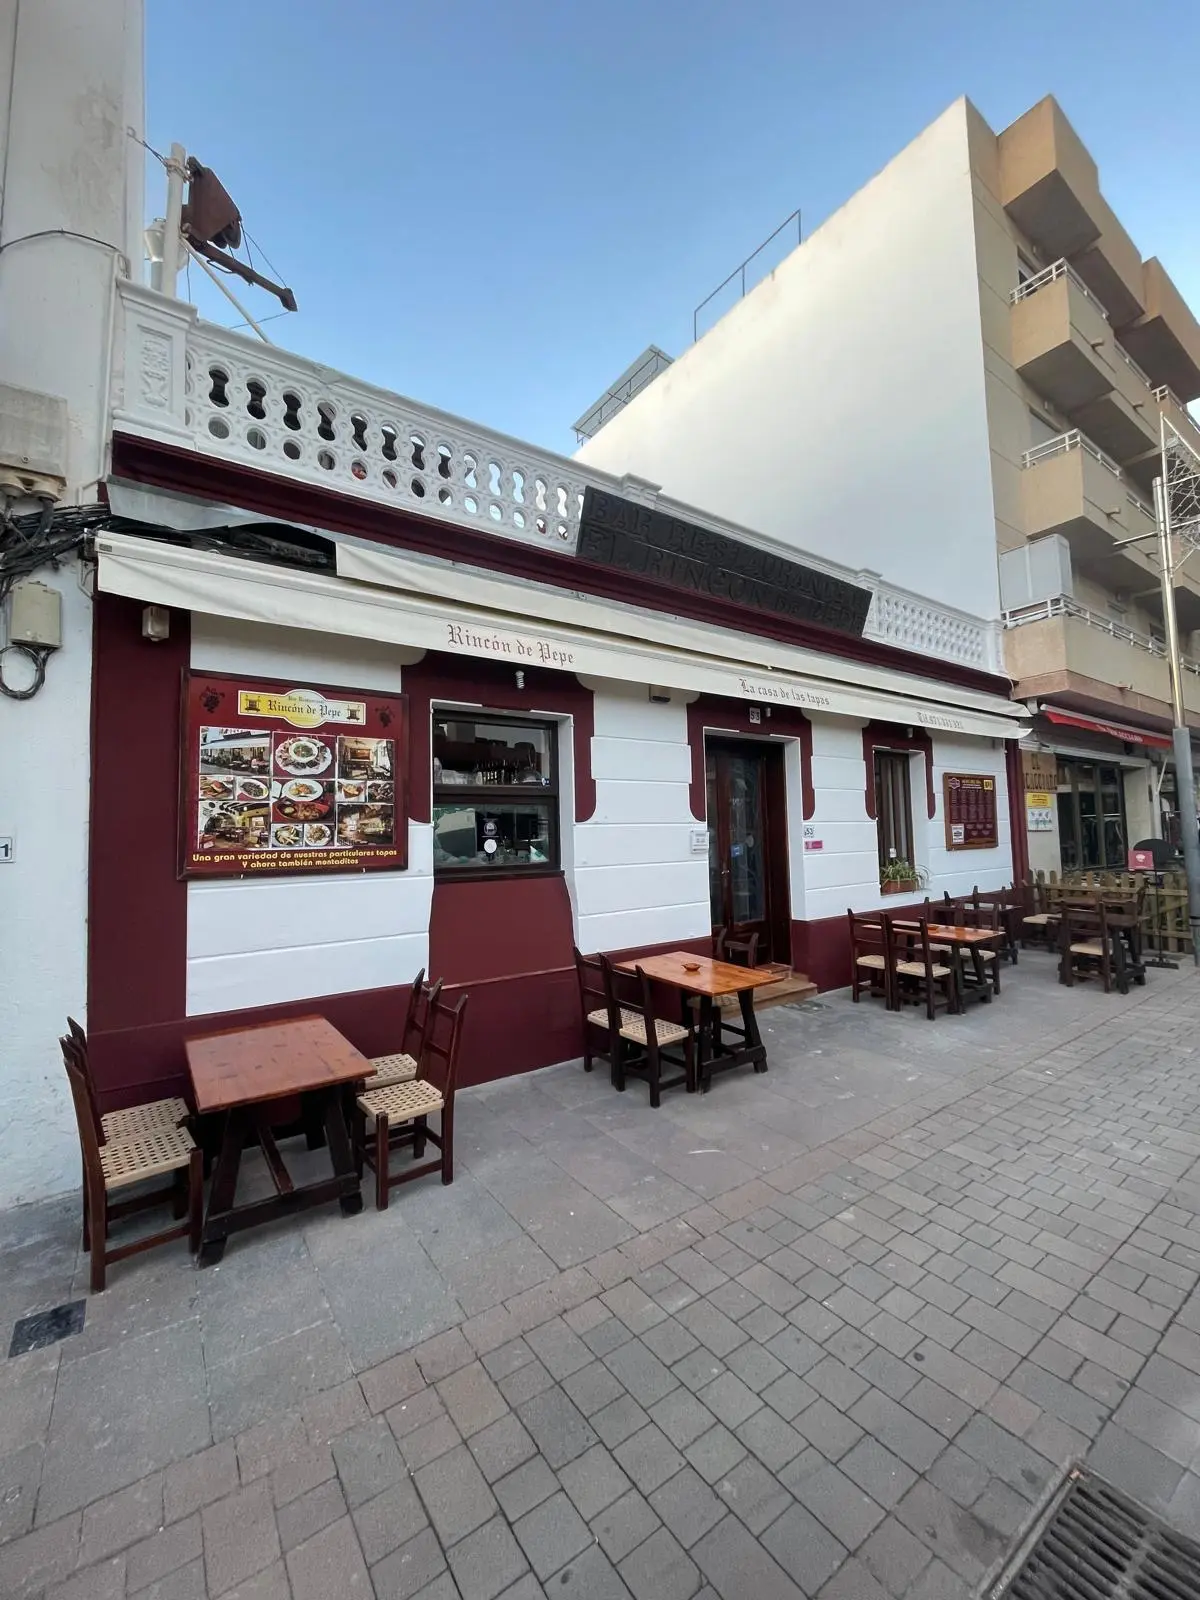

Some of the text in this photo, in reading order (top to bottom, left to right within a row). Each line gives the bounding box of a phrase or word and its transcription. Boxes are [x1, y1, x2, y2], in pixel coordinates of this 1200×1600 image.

[589, 491, 653, 542] BAR
[447, 624, 576, 667] Rincón de Pepe
[739, 678, 830, 707] La casa de las tapas
[268, 699, 304, 714] Rincón
[307, 704, 317, 715] de
[319, 704, 341, 719] Pepe
[751, 711, 760, 721] 53
[192, 849, 397, 863] Una gran variedad de nuestras particulares tapas
[242, 857, 359, 869] Y ahora también montaditos
